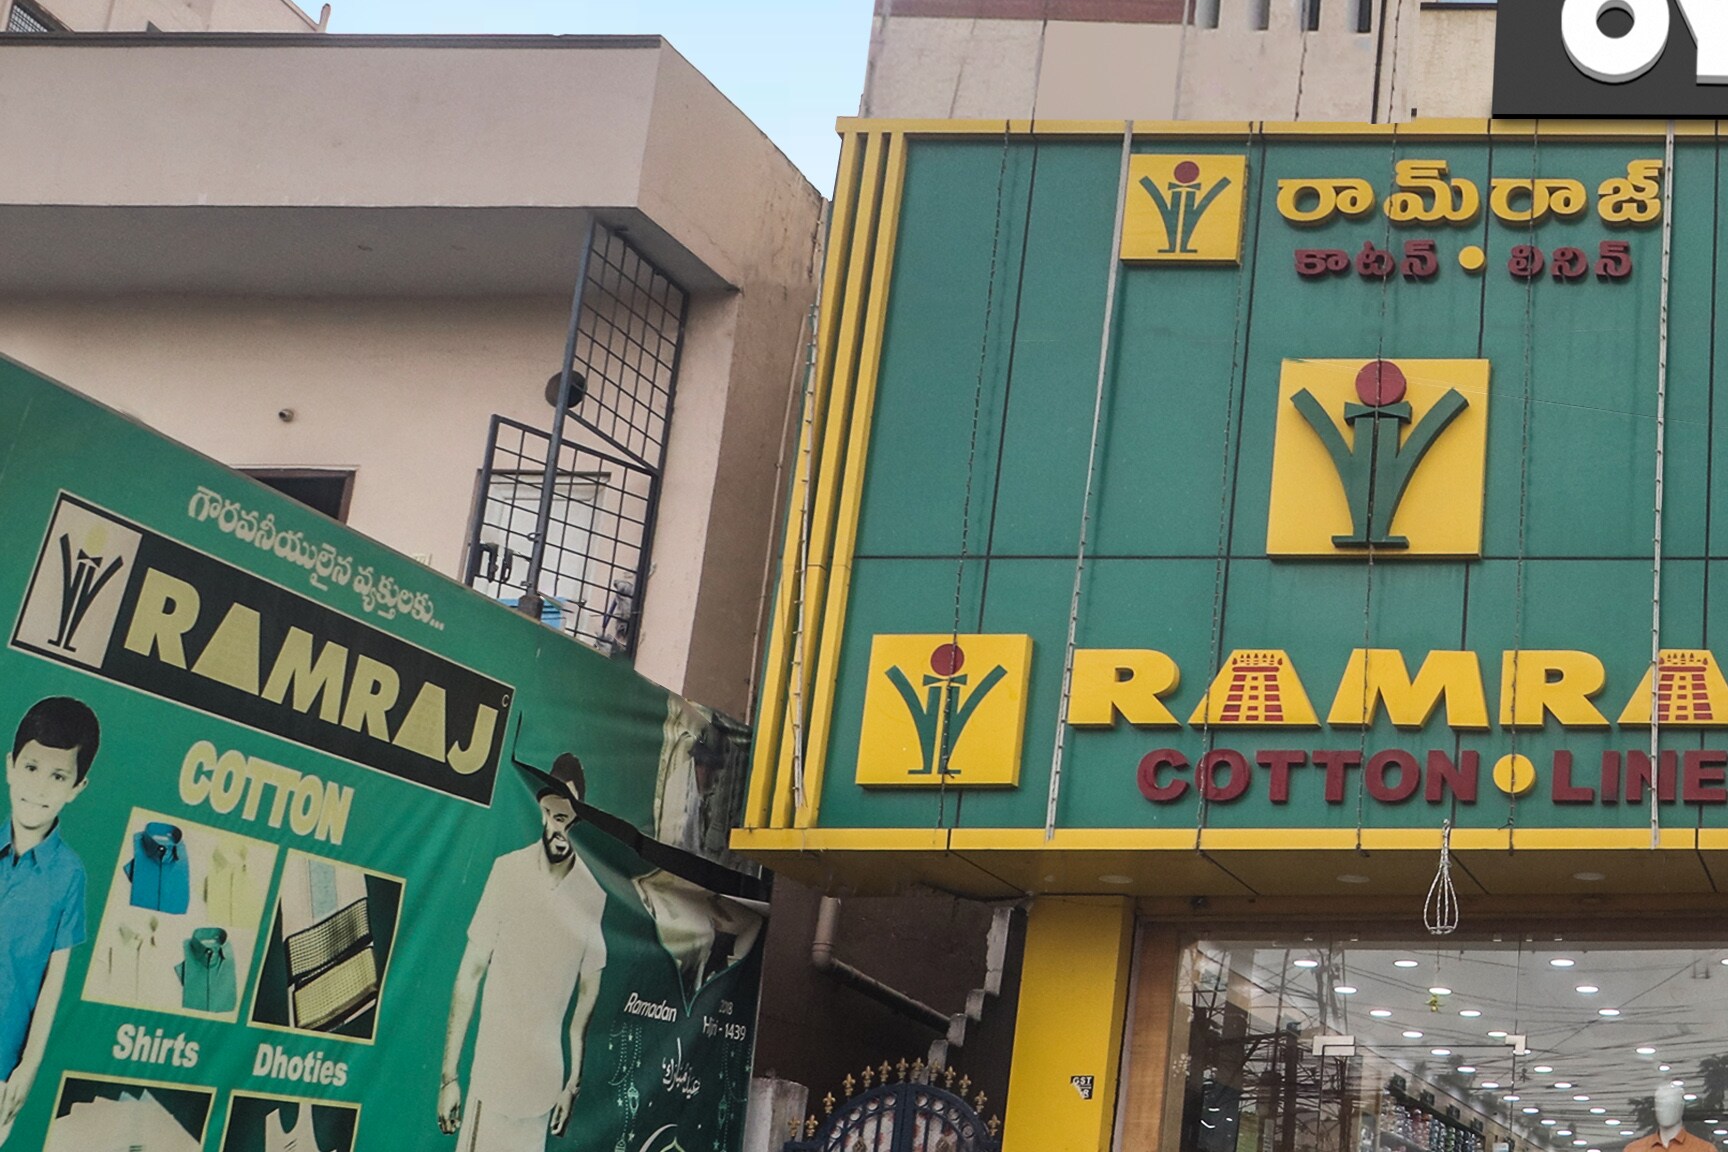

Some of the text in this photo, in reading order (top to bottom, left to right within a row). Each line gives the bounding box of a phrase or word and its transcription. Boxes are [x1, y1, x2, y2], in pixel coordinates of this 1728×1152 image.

[124, 567, 499, 775] RAMRAJ
[179, 740, 355, 845] COTTON
[1137, 749, 1481, 804] COTTON
[624, 992, 677, 1022] Ramadan
[112, 1024, 199, 1068] Shirts
[724, 1022, 747, 1041] 1439
[252, 1044, 349, 1087] Dhoties
